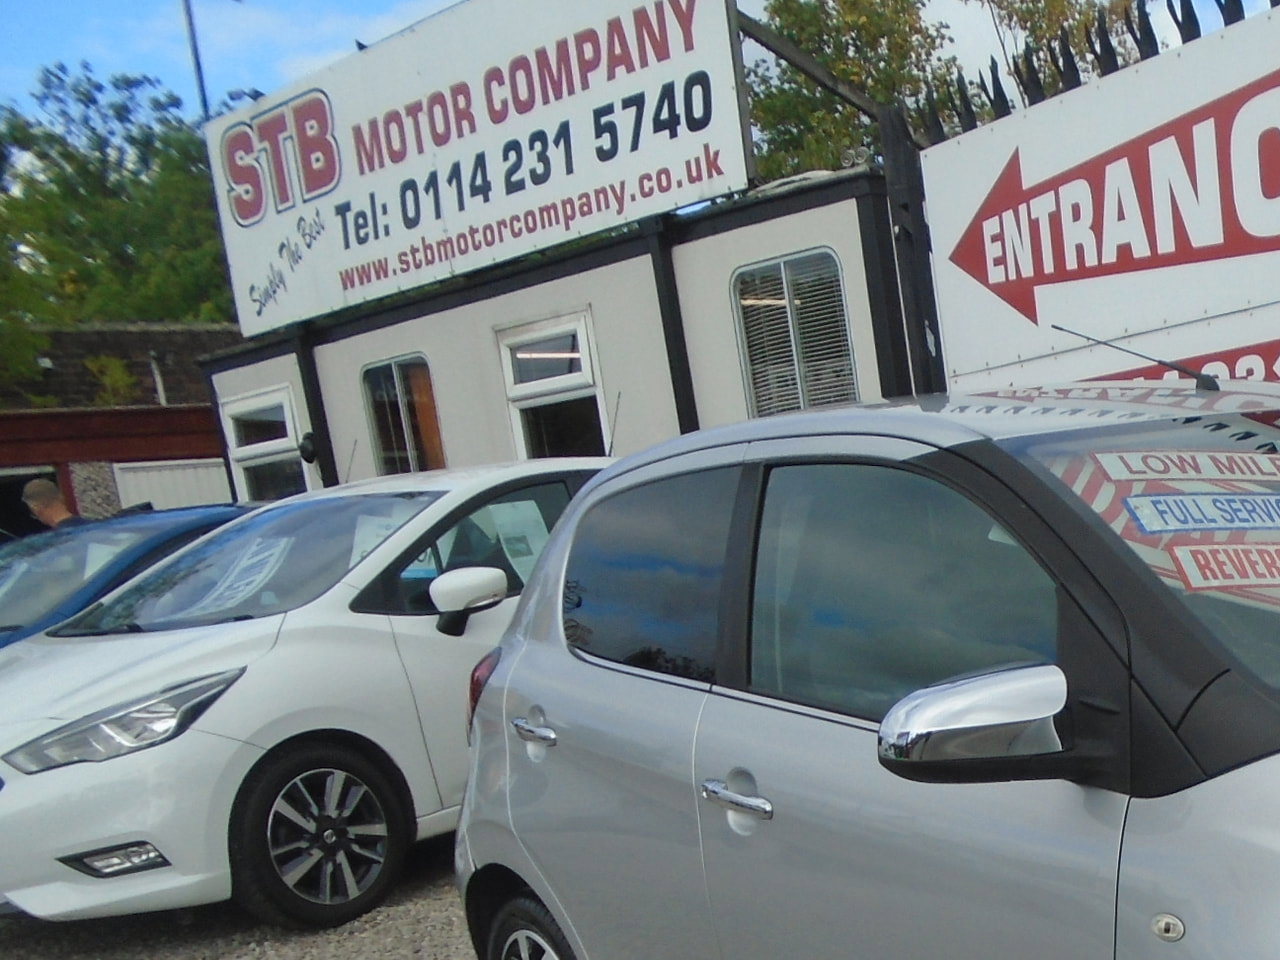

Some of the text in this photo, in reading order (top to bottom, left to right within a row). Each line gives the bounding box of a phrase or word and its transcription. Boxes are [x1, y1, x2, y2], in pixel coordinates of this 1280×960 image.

[352, 0, 697, 176] MOTOR COMPANY
[223, 91, 339, 226] STB
[334, 70, 713, 250] Tel: 0114 231 5740
[339, 143, 724, 291] www.stbmotorcompany.co.uk
[296, 206, 325, 250] Best
[1118, 454, 1202, 475] LOW
[1149, 500, 1216, 525] FULL
